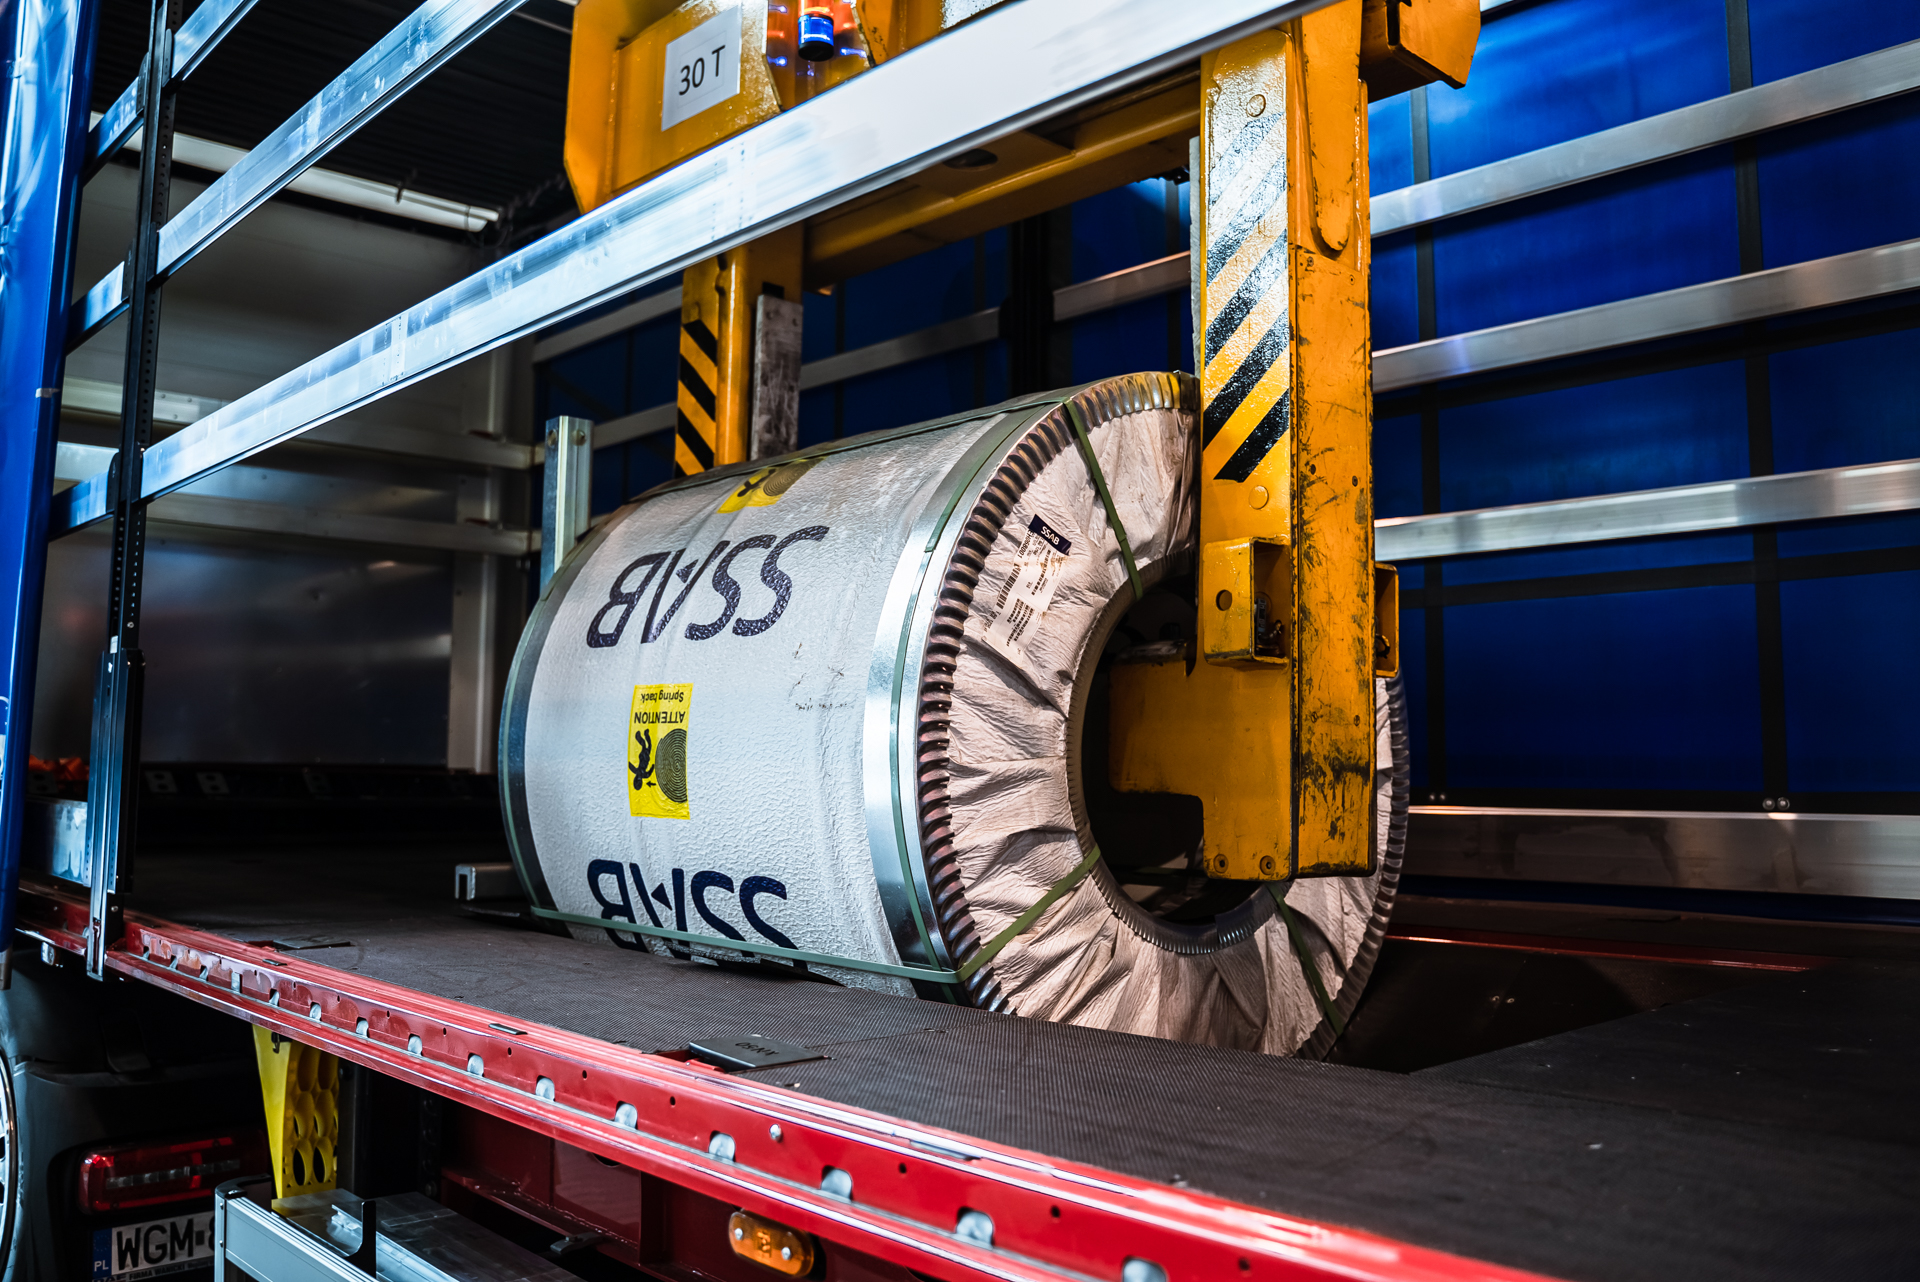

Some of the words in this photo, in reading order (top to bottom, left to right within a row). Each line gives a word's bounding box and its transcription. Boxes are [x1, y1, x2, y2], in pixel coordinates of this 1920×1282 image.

[679, 57, 705, 96] 30
[711, 44, 726, 77] T
[1040, 525, 1060, 546] SSAB
[586, 525, 830, 648] SSAB
[640, 692, 658, 704] back
[658, 689, 685, 703] Spring
[633, 711, 686, 724] ATTENTION
[116, 1217, 195, 1271] WGM
[93, 1260, 109, 1272] PL
[129, 1270, 153, 1281] FIRMA
